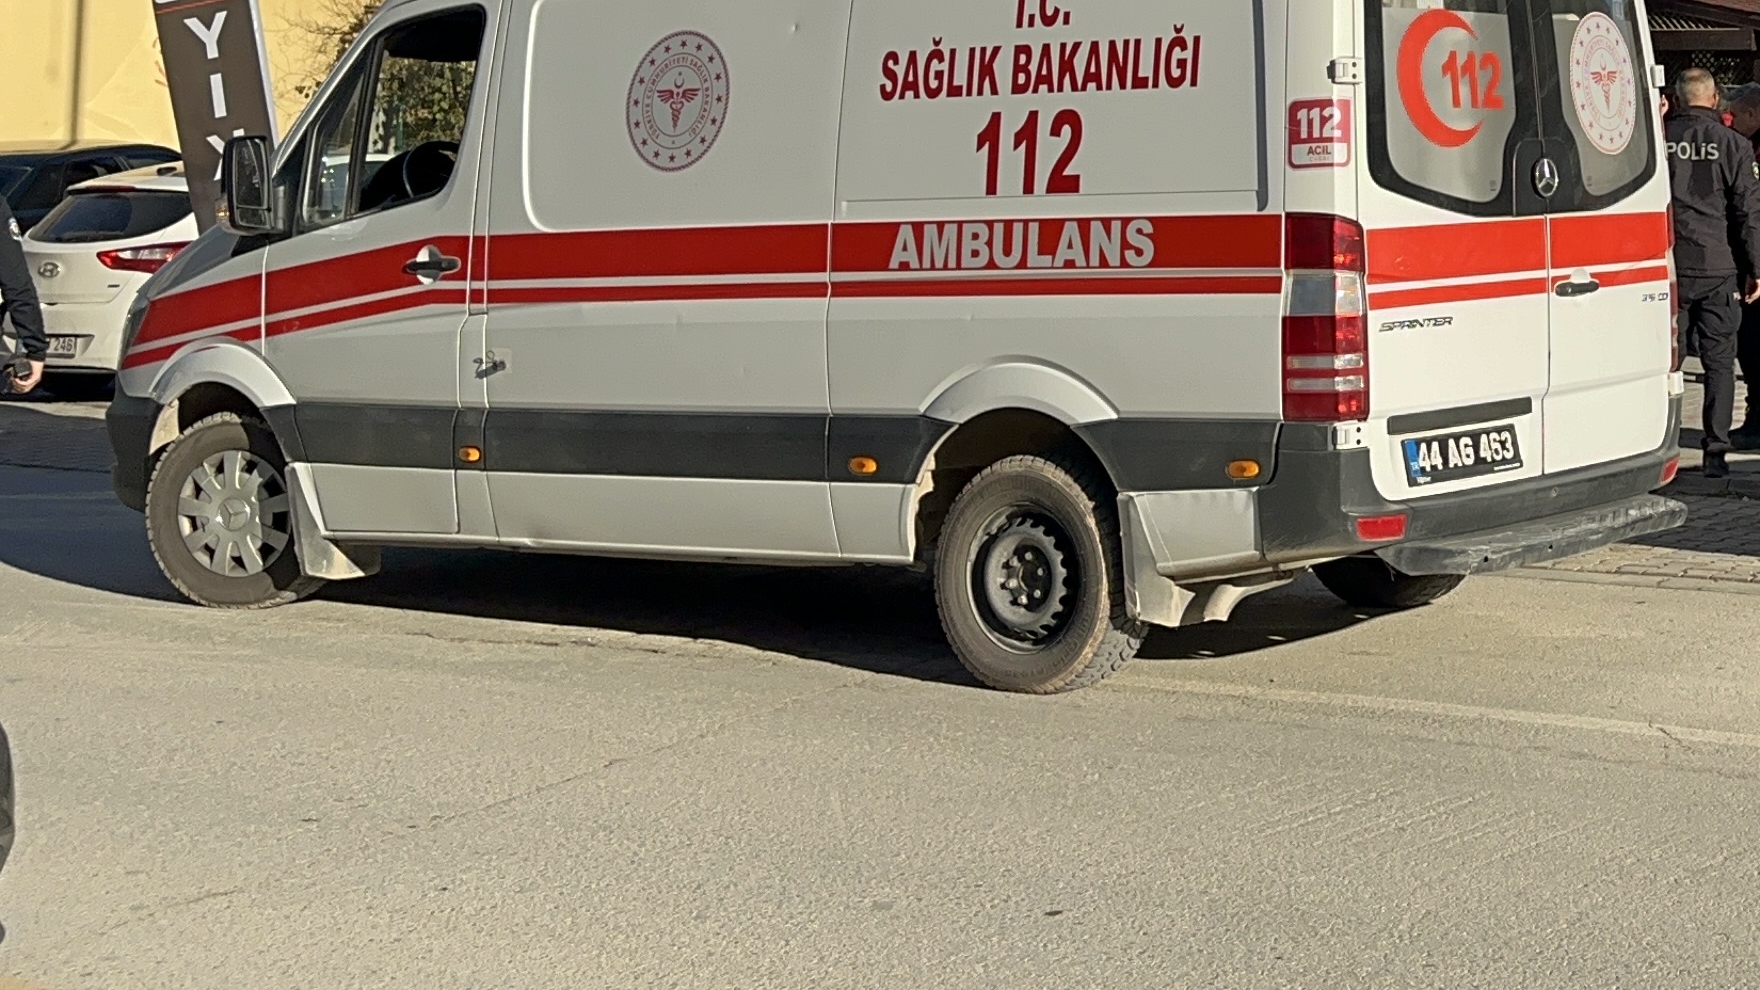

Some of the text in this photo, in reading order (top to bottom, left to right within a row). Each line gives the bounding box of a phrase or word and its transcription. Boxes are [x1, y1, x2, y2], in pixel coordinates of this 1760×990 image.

[879, 23, 1201, 101] SAĞLIK BAKANLIĞI
[1441, 49, 1505, 111] 112
[1297, 106, 1342, 139] 112
[975, 109, 1083, 196] 112
[888, 218, 1155, 269] AMBULANS
[54, 338, 73, 351] 246
[1378, 316, 1453, 332] SPRINTER
[1418, 430, 1514, 472] 44 AG 463
